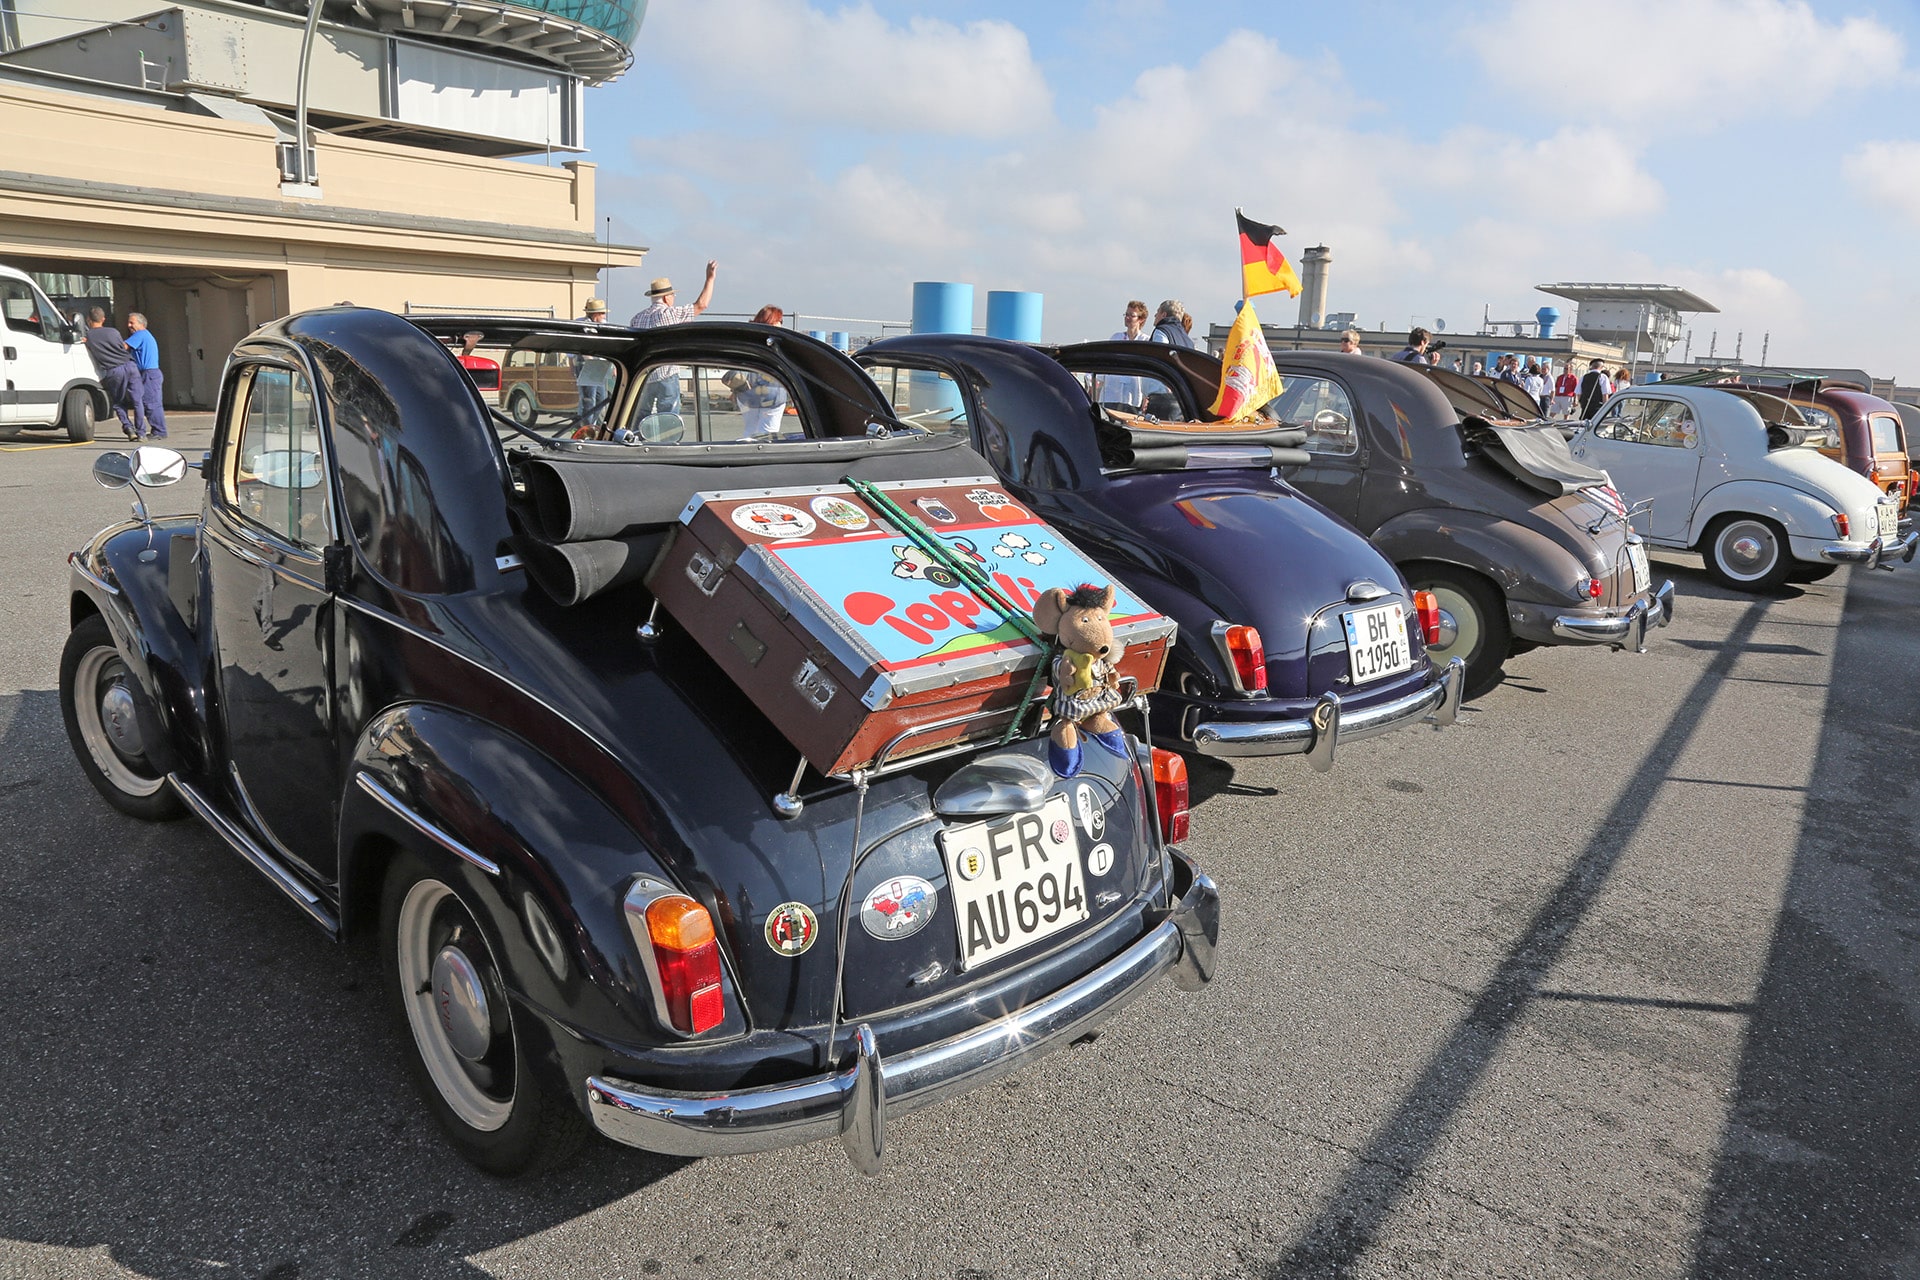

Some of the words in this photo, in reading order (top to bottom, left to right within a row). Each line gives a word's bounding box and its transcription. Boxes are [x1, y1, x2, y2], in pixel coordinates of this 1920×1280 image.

[1367, 611, 1389, 642] BH
[986, 813, 1049, 881] FR
[1097, 849, 1107, 871] D
[440, 983, 454, 1032] FIAT
